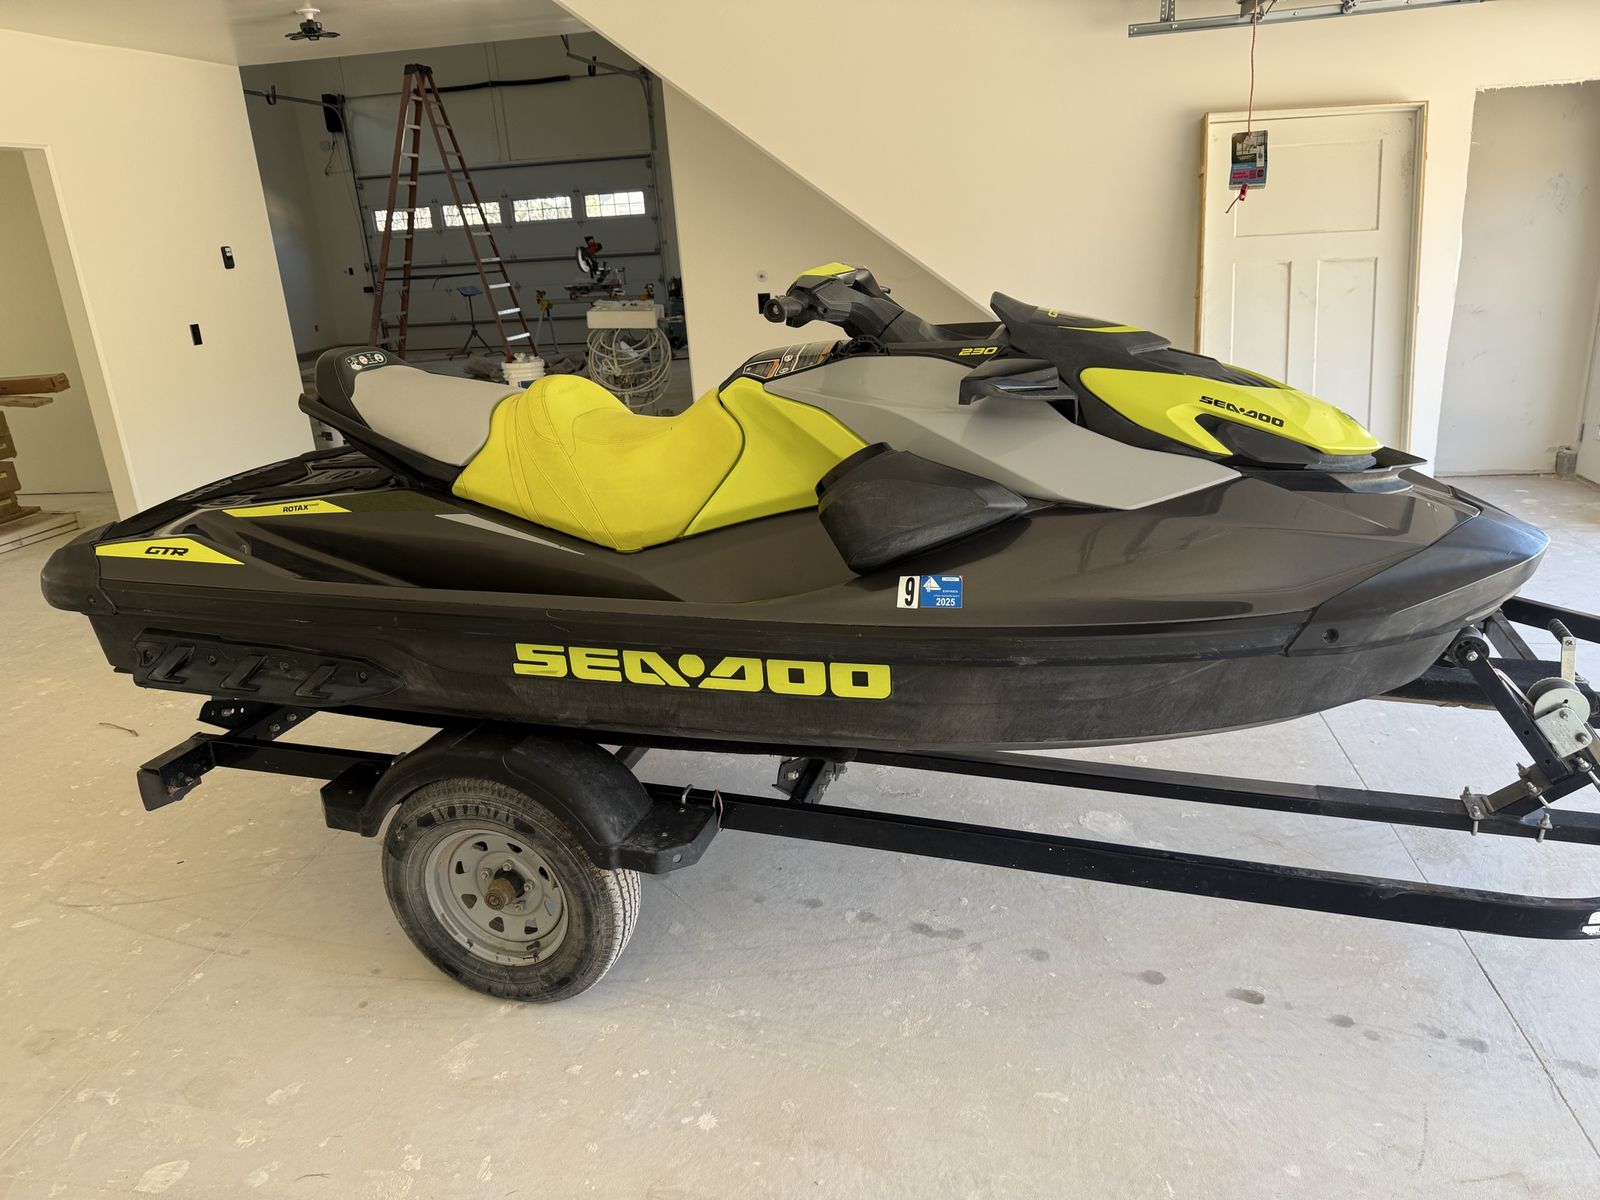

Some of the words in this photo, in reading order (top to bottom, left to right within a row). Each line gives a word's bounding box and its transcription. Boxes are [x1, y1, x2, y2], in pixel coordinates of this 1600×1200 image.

[958, 346, 998, 356] 230
[282, 504, 309, 513] ROTAX
[144, 546, 189, 557] GTR
[904, 576, 915, 607] 9
[935, 597, 956, 606] 2025
